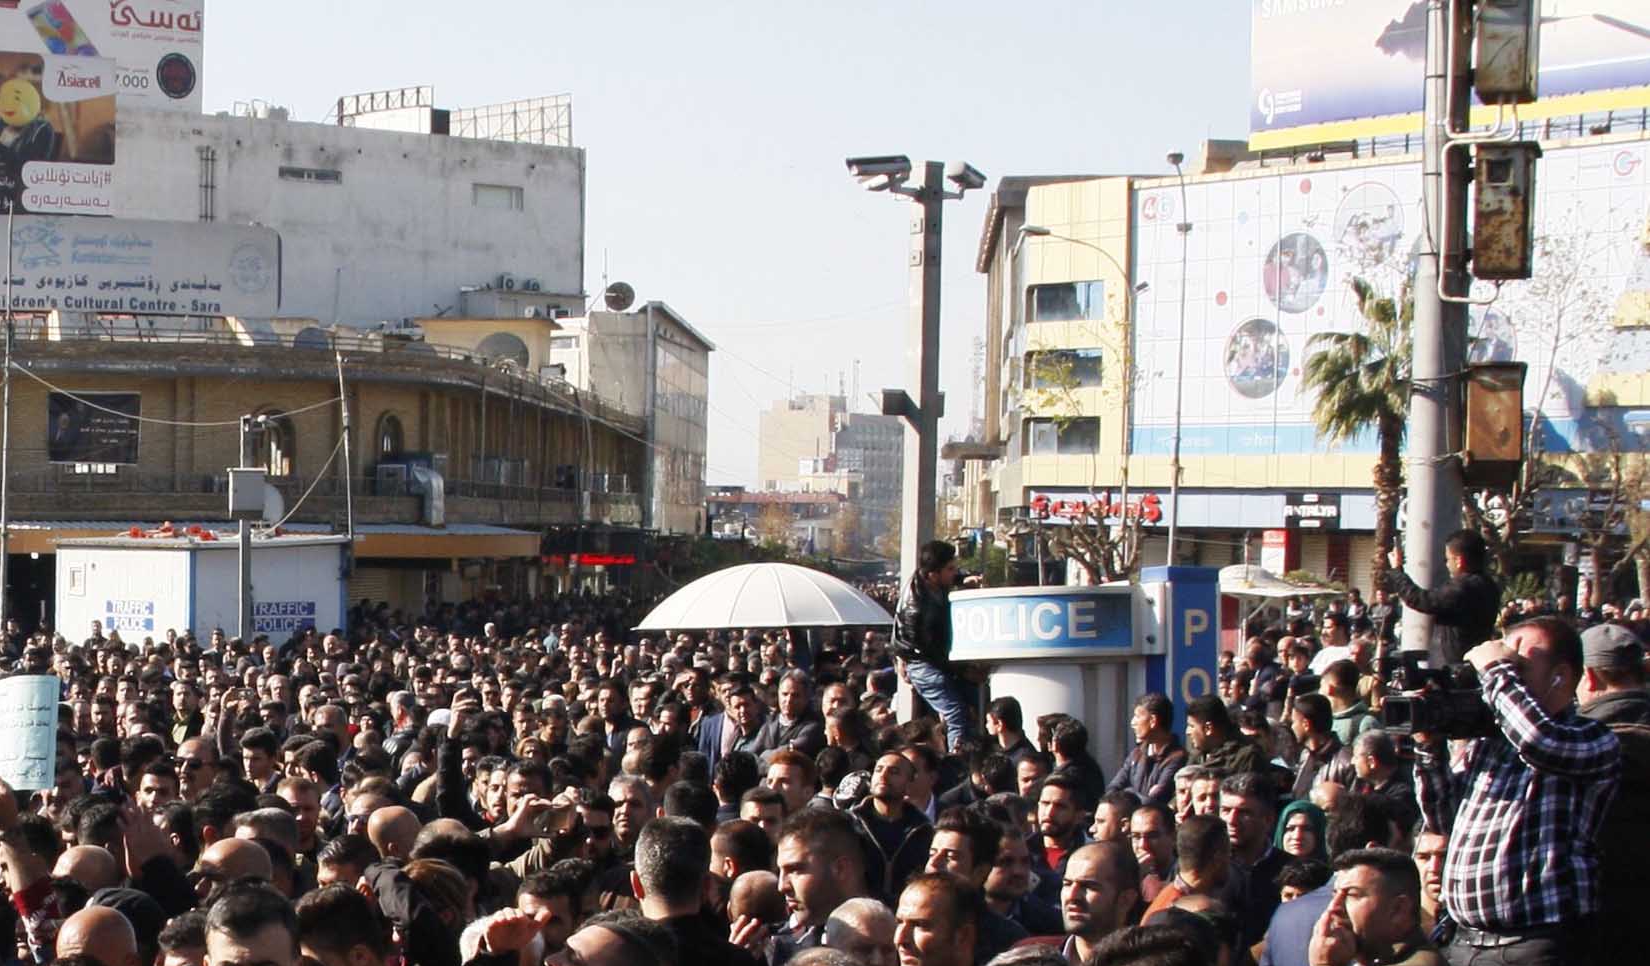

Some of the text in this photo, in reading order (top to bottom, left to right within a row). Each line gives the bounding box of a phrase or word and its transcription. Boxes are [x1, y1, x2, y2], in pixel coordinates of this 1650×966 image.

[64, 295, 123, 310] Cultural
[129, 297, 176, 311] Centre
[191, 299, 221, 313] Sara
[112, 600, 150, 615] TRAFFIC
[252, 602, 308, 615] TRAFFIC
[953, 601, 1097, 642] POLICE
